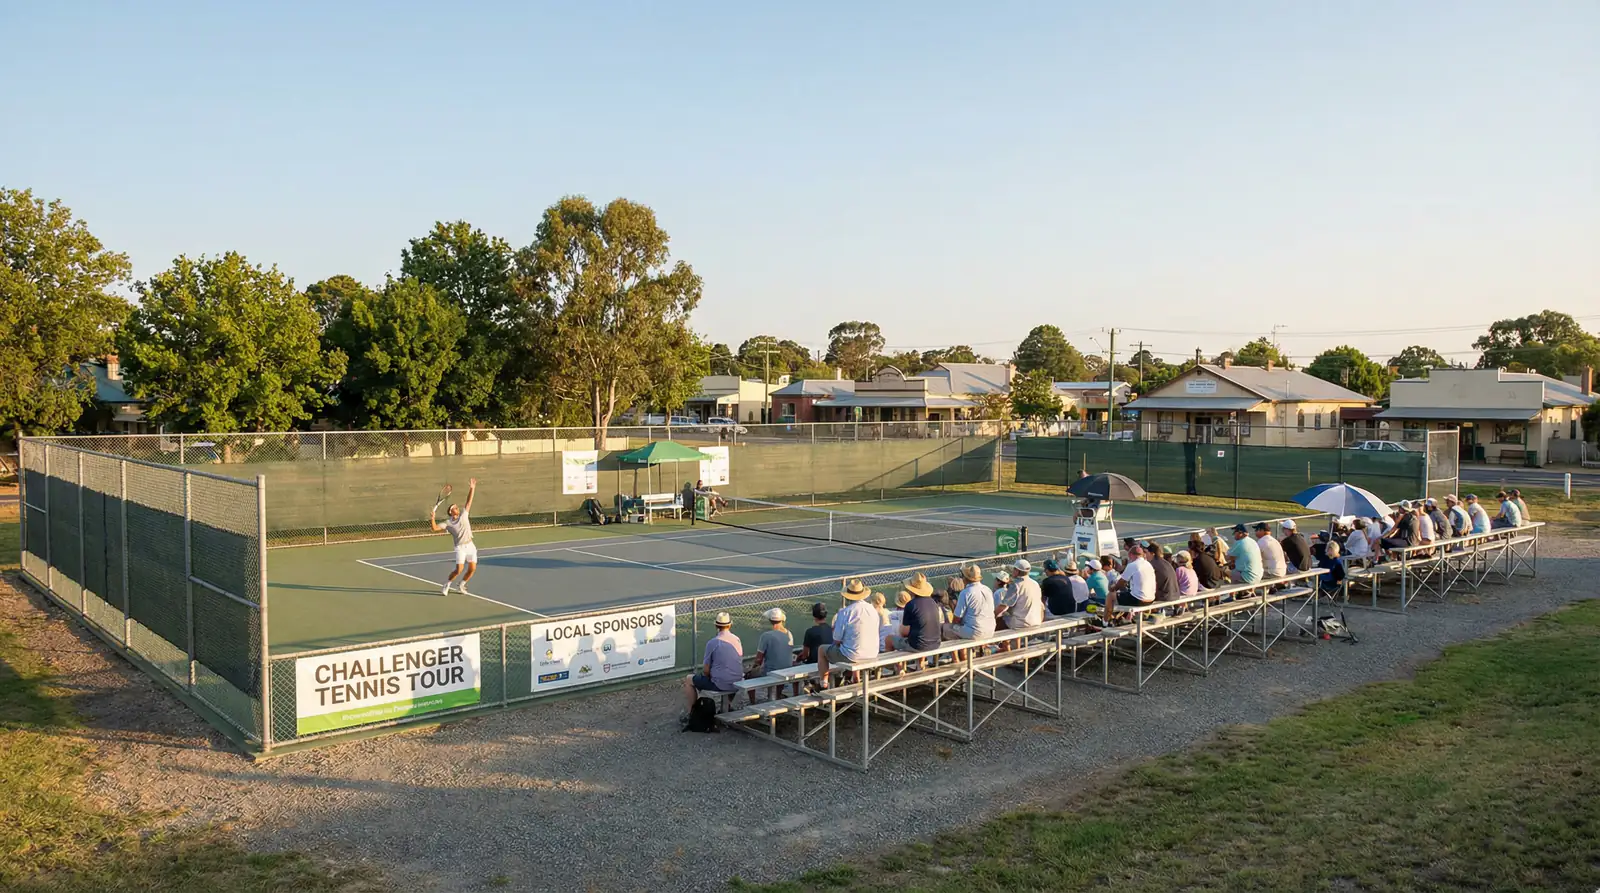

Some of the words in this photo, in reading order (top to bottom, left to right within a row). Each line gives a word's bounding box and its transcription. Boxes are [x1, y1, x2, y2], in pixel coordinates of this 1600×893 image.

[545, 623, 590, 642] LOCAL
[593, 612, 664, 635] SPONSORS
[315, 645, 464, 685] CHALLENGER
[315, 676, 400, 706] TENNIS
[406, 665, 465, 691] TOUR
